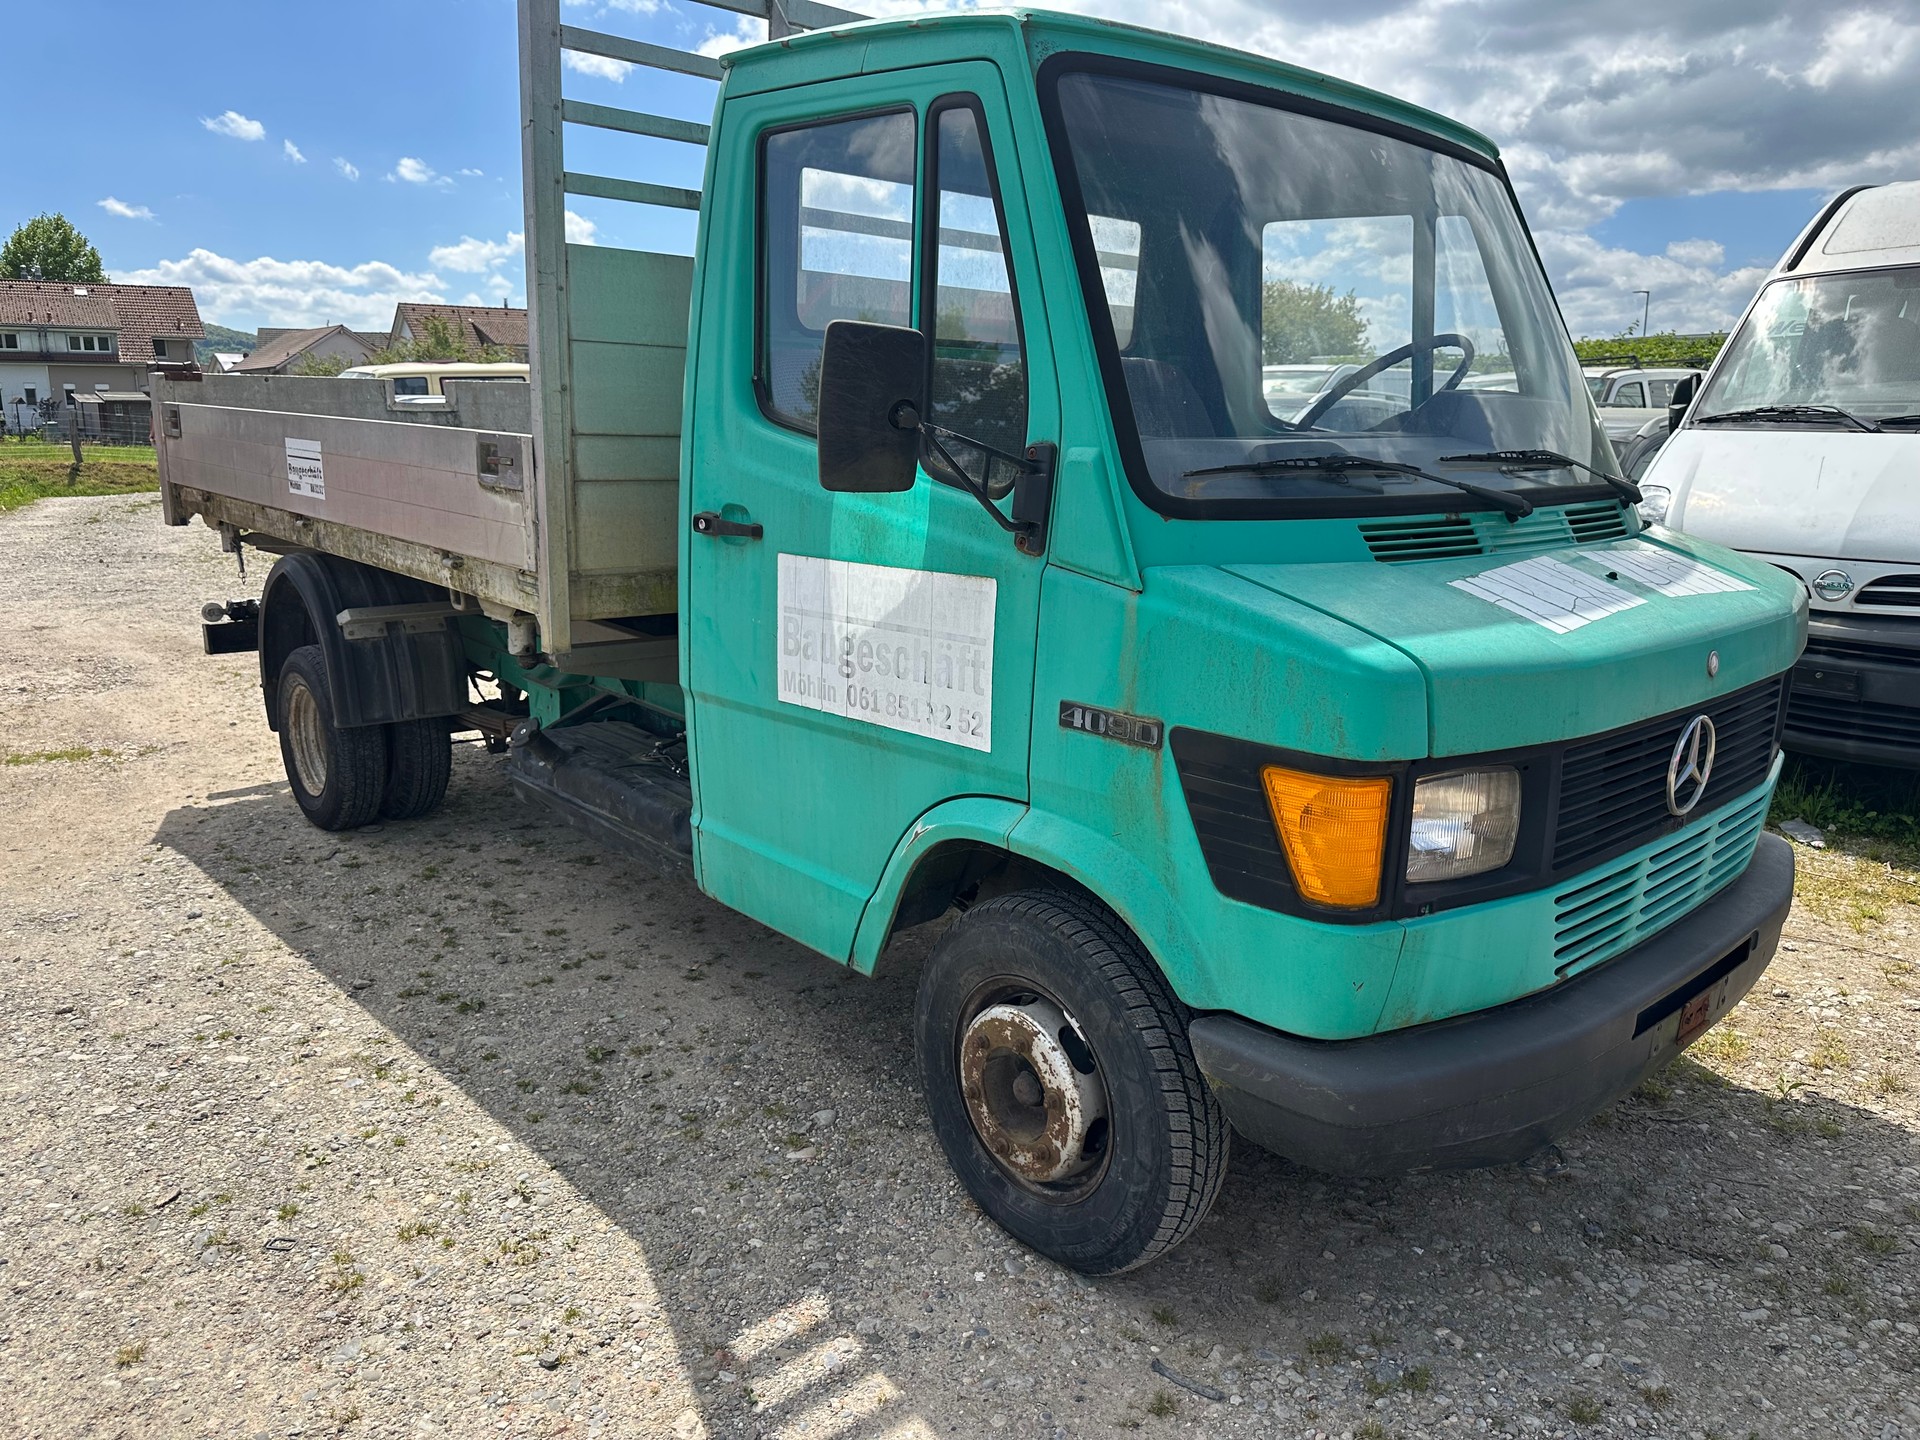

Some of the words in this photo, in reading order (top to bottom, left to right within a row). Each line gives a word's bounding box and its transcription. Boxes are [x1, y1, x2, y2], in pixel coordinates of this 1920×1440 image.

[783, 615, 986, 696] Baugeschäft
[783, 669, 837, 703] Möhlin
[846, 684, 881, 714] 061
[885, 692, 921, 723] 851
[958, 707, 984, 737] 52
